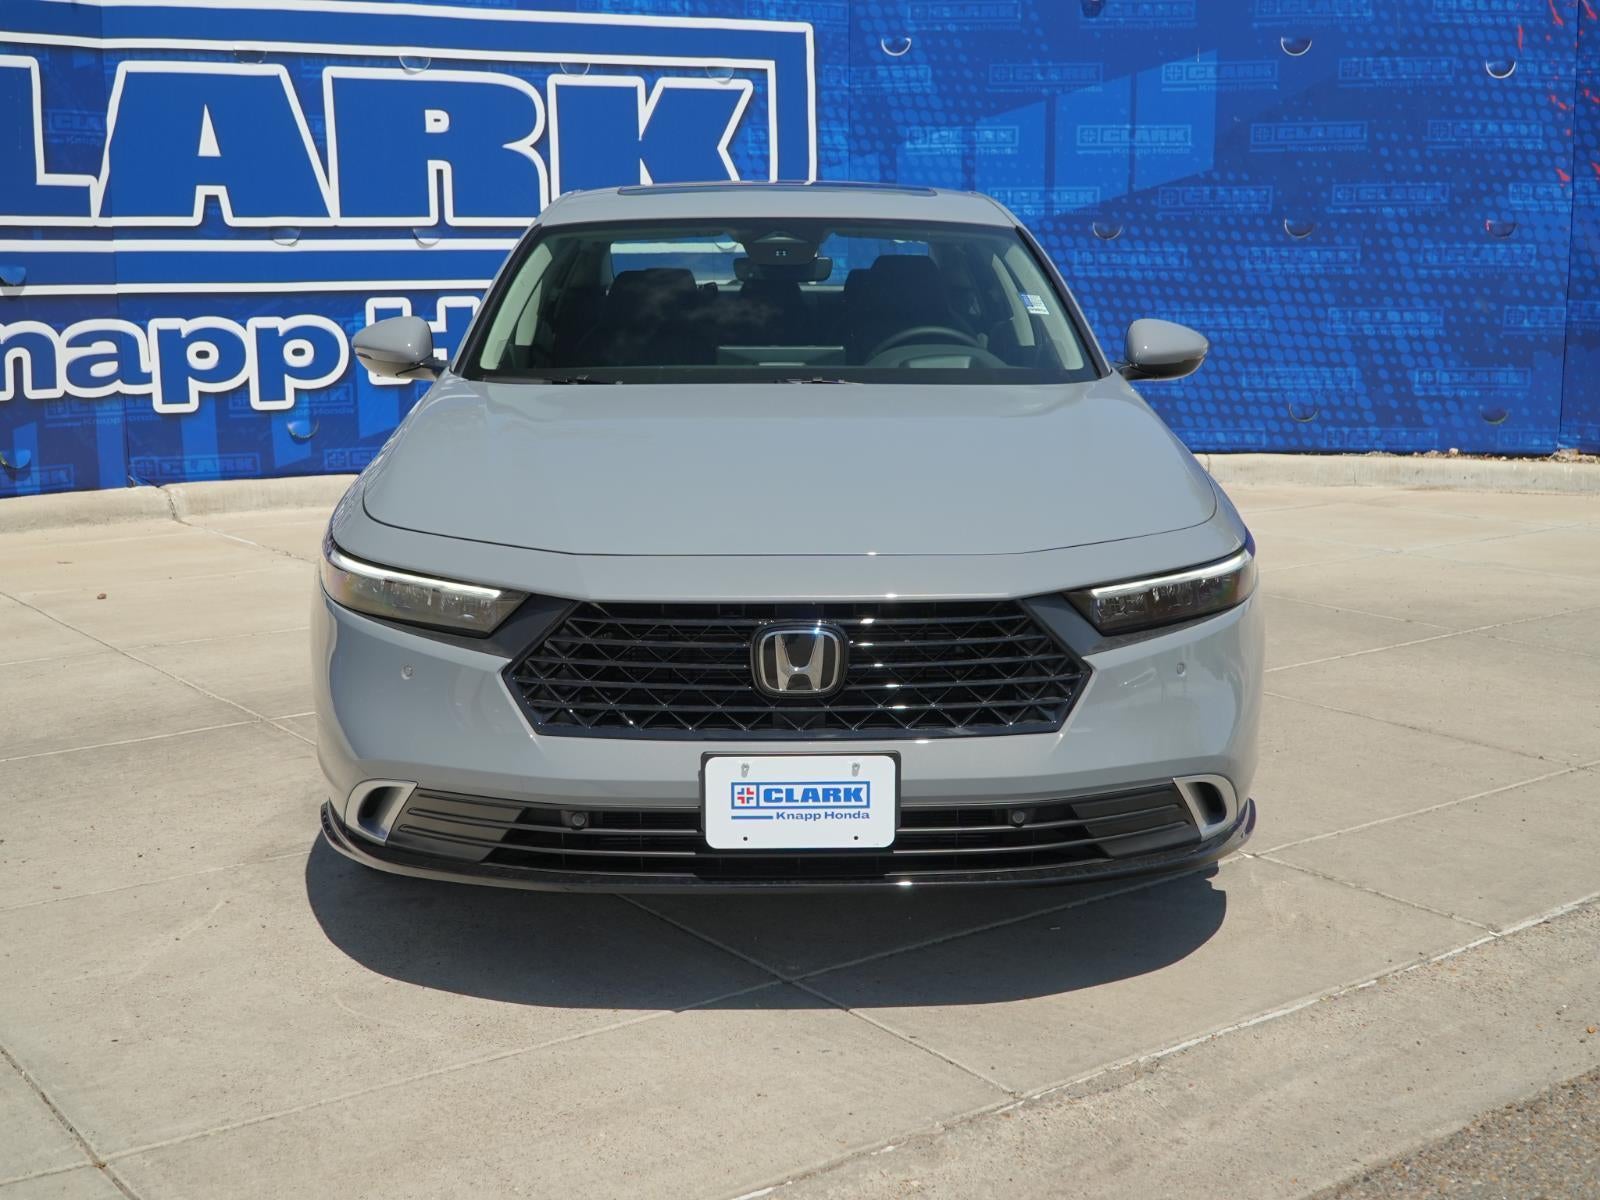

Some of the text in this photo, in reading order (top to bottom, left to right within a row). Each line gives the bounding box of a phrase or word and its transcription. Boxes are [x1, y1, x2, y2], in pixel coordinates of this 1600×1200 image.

[1188, 65, 1273, 79] CLARK
[1103, 128, 1186, 142] CLARK
[1277, 126, 1362, 141] CLARK
[763, 787, 863, 803] CLARK
[776, 811, 870, 821] Knapp Honda
